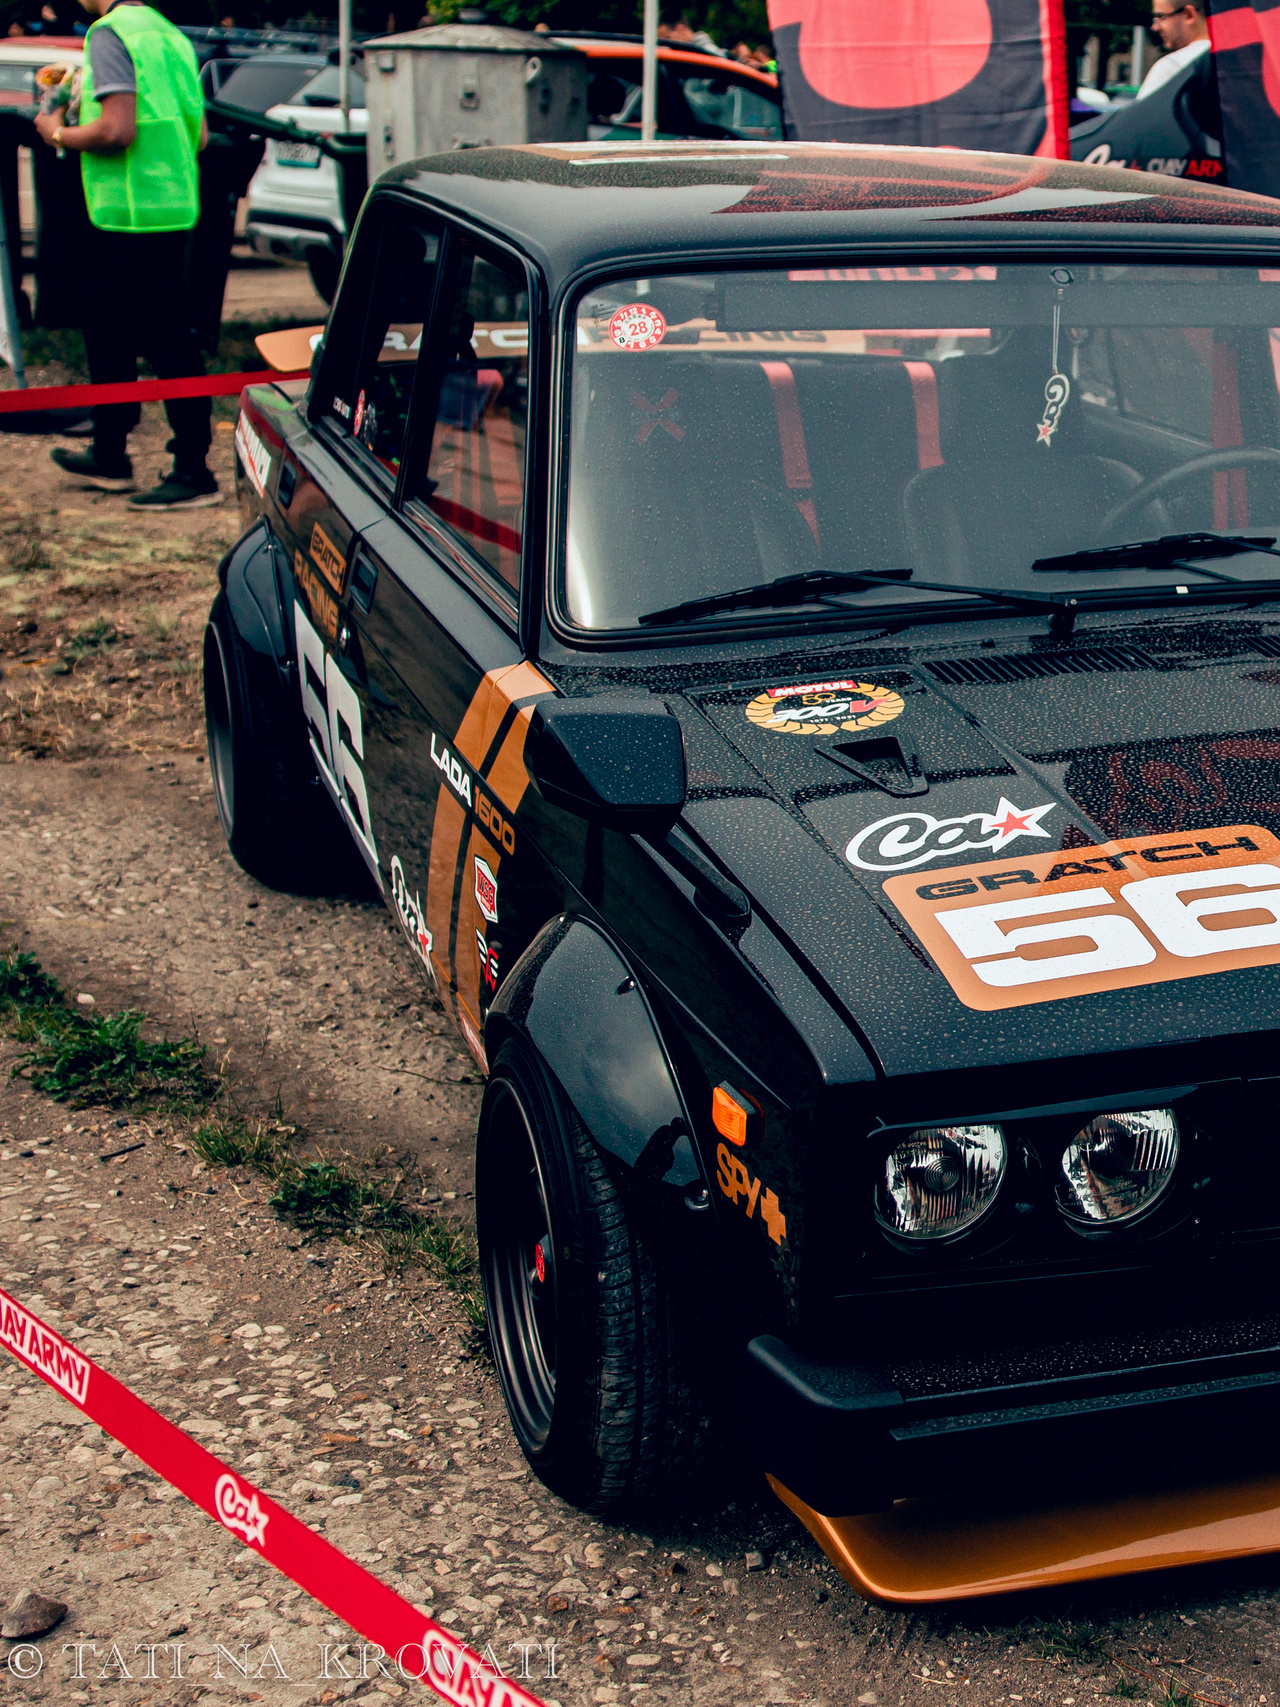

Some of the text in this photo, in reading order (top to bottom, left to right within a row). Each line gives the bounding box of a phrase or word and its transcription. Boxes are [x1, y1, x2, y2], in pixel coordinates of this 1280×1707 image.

[628, 321, 648, 337] 28
[773, 681, 853, 697] MOTUL
[802, 692, 836, 706] 50
[765, 698, 890, 724] 300V
[430, 732, 515, 856] LADA 1600
[916, 835, 1261, 901] GRATCH
